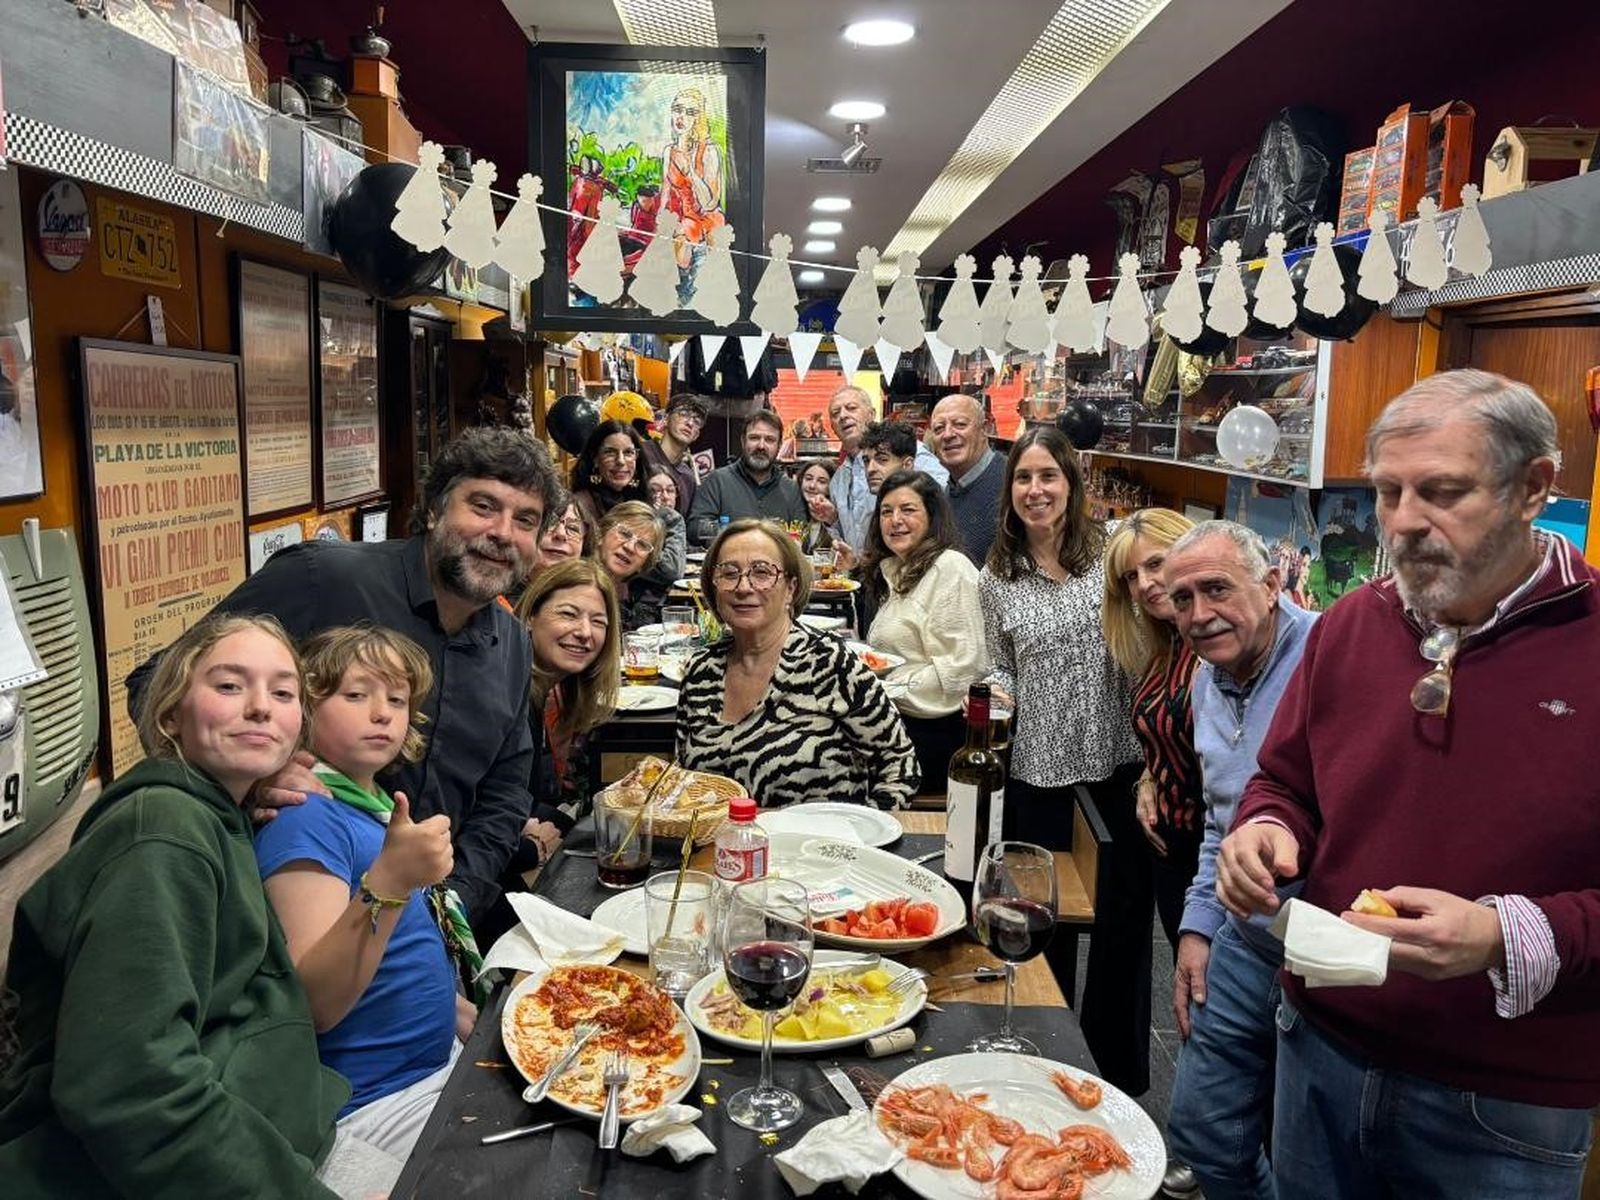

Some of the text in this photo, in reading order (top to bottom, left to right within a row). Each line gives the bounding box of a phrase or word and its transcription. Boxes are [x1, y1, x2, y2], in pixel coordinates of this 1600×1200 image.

[103, 223, 177, 273] CTZ 752
[89, 362, 235, 410] CARRERAS DE MOTOS
[94, 443, 145, 463] PLAYA
[146, 442, 164, 460] DE
[166, 441, 183, 460] LA
[184, 438, 238, 457] VICTORIA
[97, 482, 141, 521] MOTO
[145, 479, 178, 515] CLUB
[184, 472, 240, 509] GADITANO
[159, 518, 170, 530] por
[127, 536, 162, 584] GRAN
[167, 527, 209, 575] PREMIO
[213, 520, 243, 563] CADIZ
[133, 630, 147, 641] DIA
[134, 614, 164, 629] ORDEN
[167, 608, 182, 618] DEL
[3, 772, 20, 822] 9
